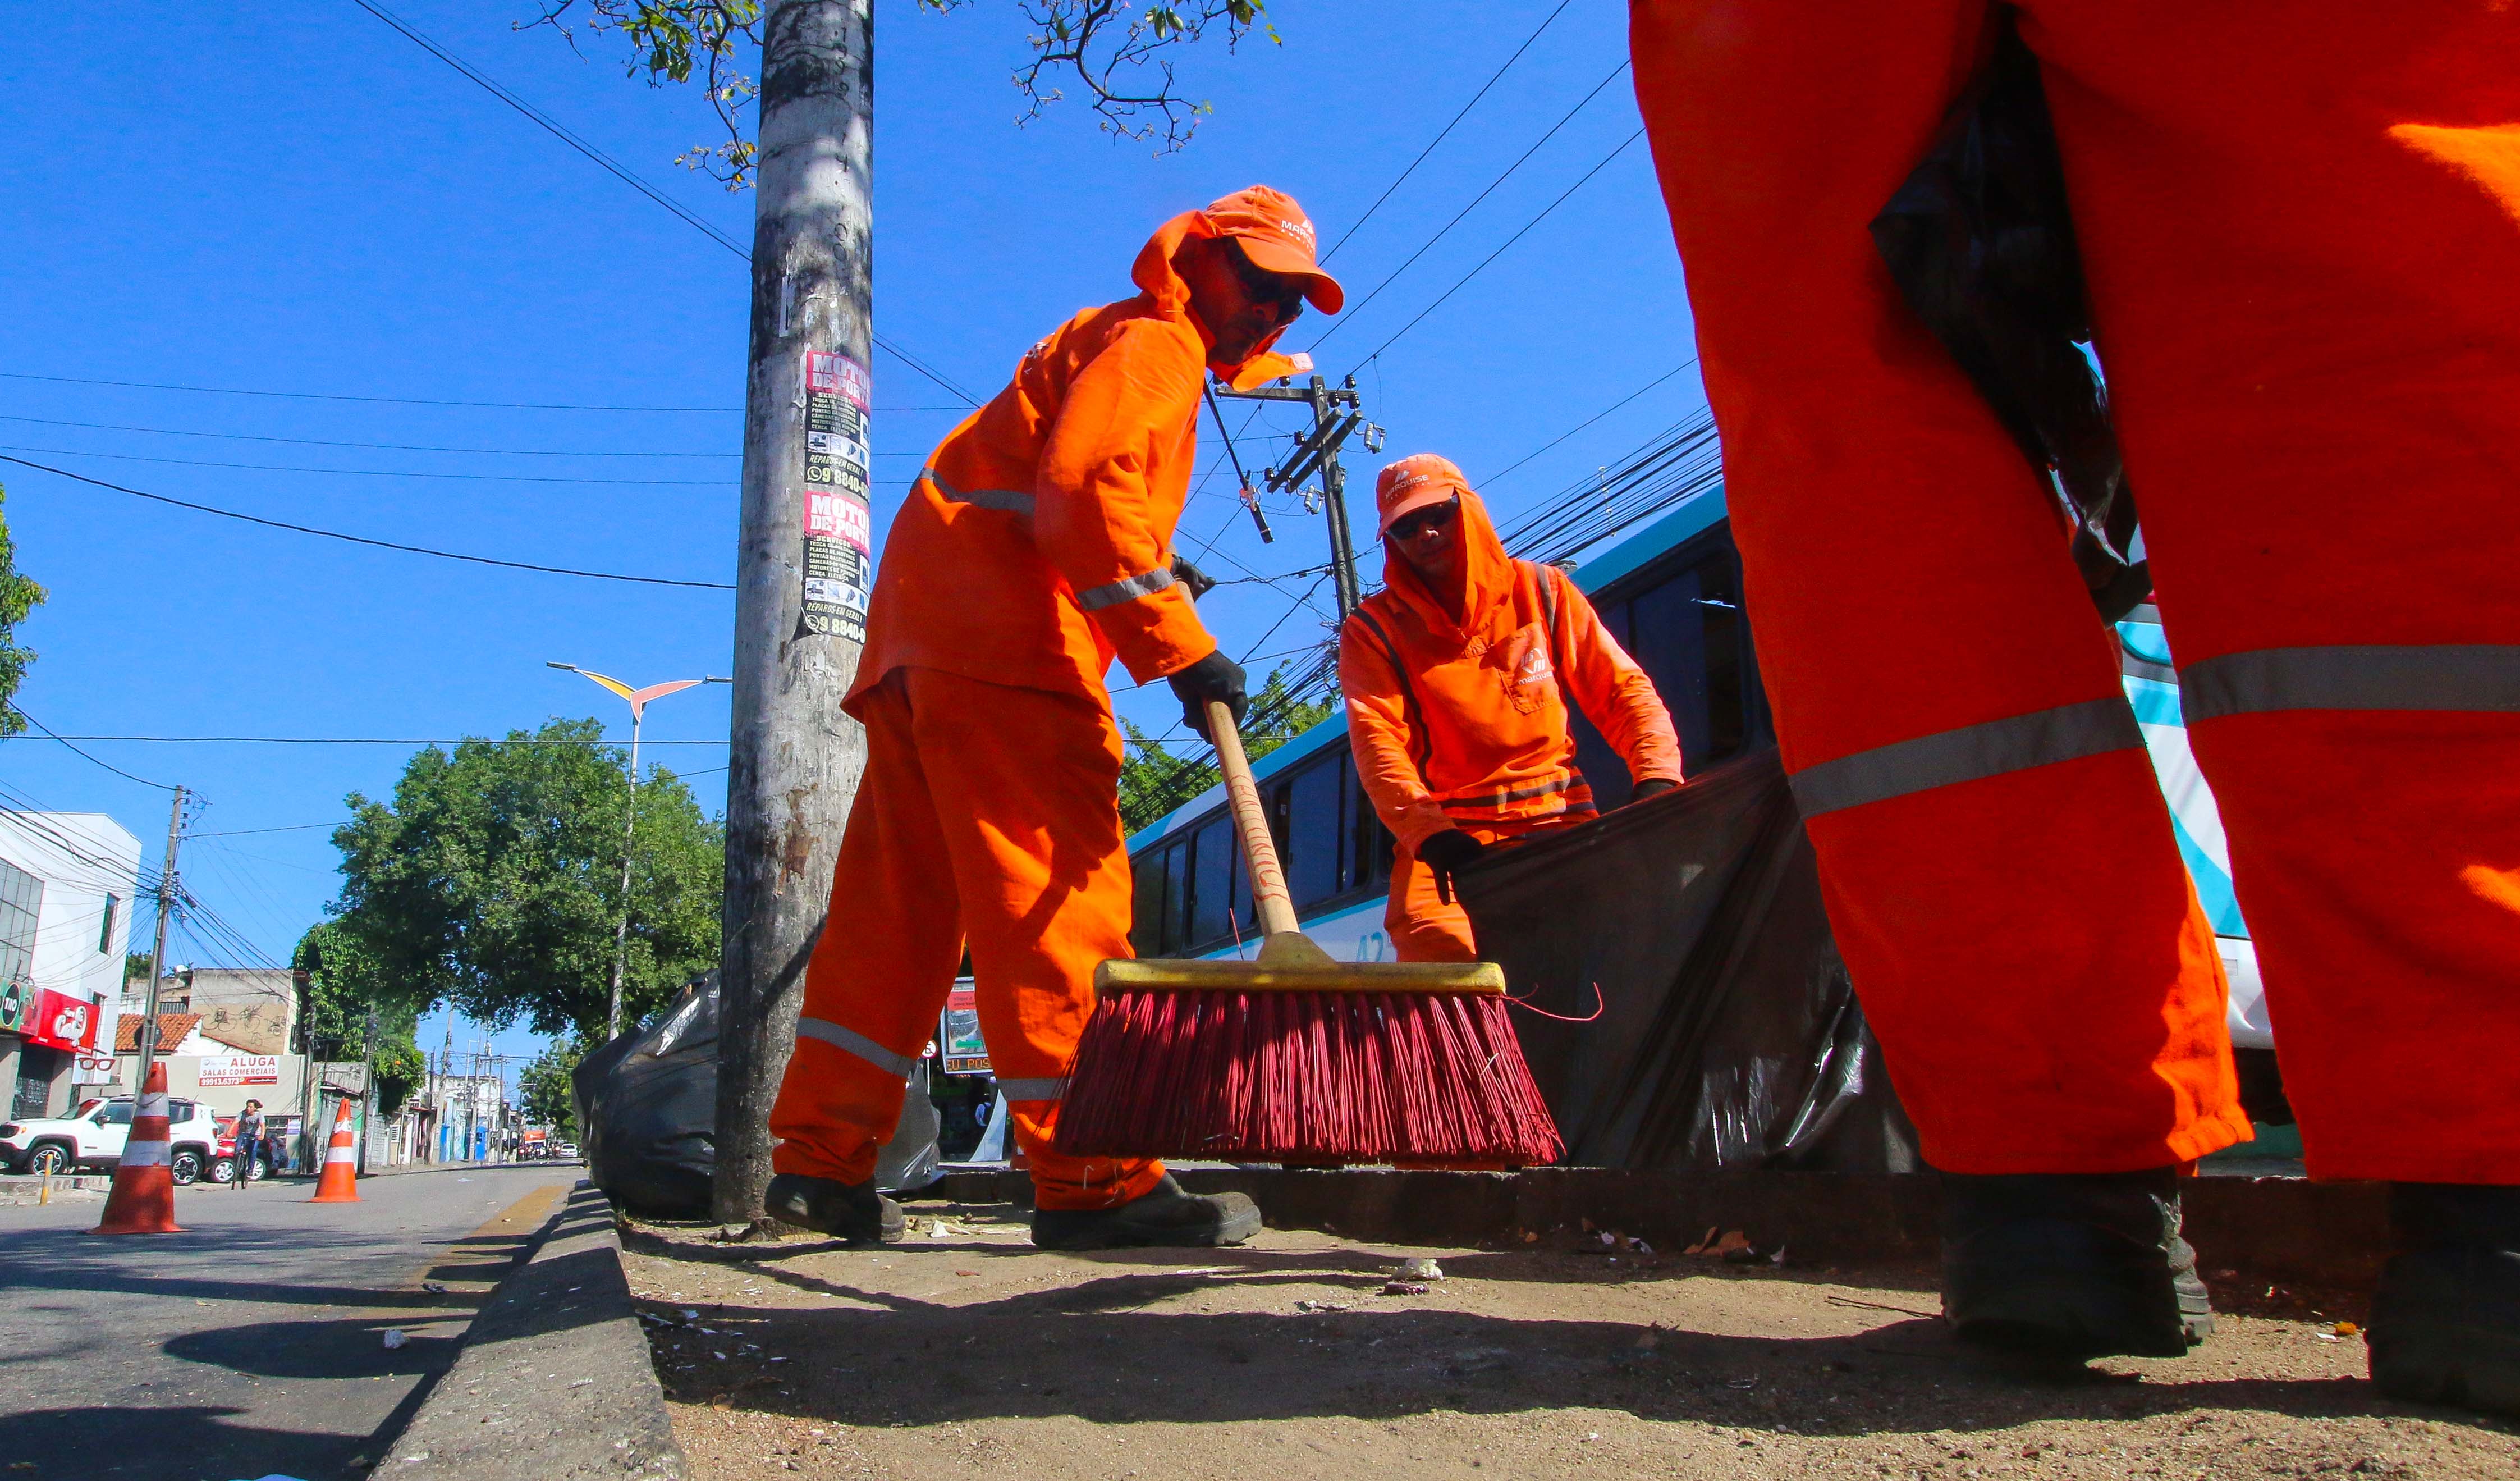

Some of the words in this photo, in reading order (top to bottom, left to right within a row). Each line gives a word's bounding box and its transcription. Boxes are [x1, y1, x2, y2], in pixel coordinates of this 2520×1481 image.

[1281, 220, 1315, 250] MARQU
[813, 373, 833, 388] DE
[1385, 474, 1428, 499] MARQUISE
[810, 514, 832, 531] DE
[807, 602, 836, 614] REPAROS
[836, 606, 846, 616] EM
[1518, 670, 1552, 685] marqu
[230, 1057, 276, 1067] ALUGA
